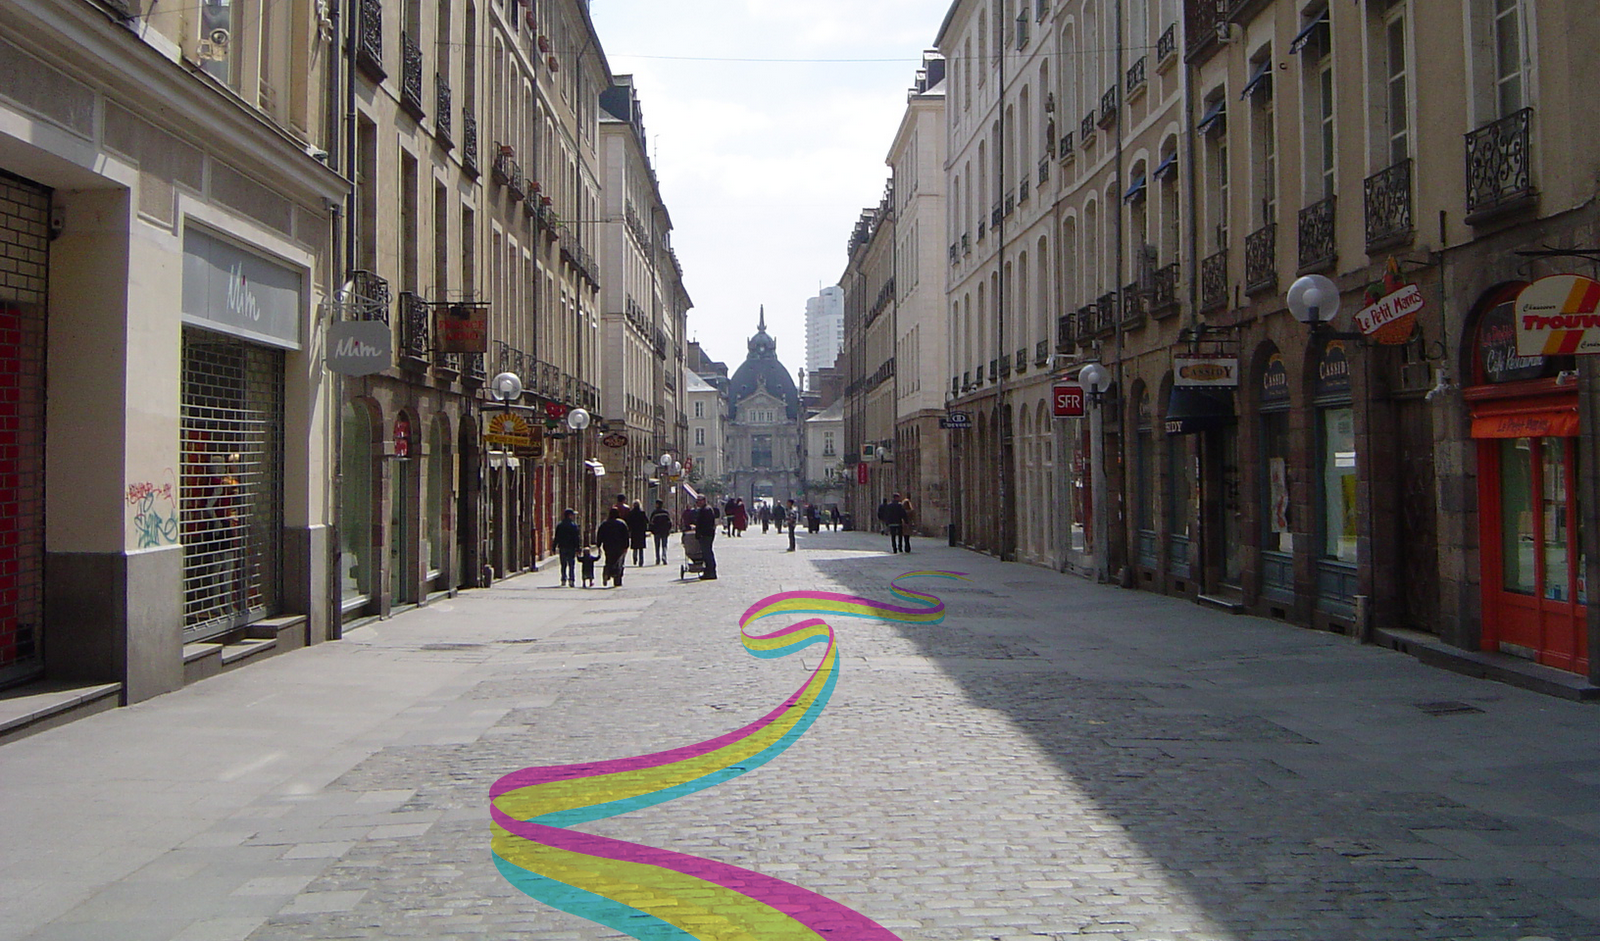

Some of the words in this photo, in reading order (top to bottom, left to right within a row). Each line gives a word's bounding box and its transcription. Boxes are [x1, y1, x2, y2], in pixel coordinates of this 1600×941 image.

[1356, 317, 1371, 332] Le
[1370, 303, 1394, 326] Petit
[335, 337, 382, 359] Mim
[1179, 366, 1232, 379] CASSIDY
[1263, 372, 1289, 390] CASSID
[1057, 394, 1081, 408] SFR
